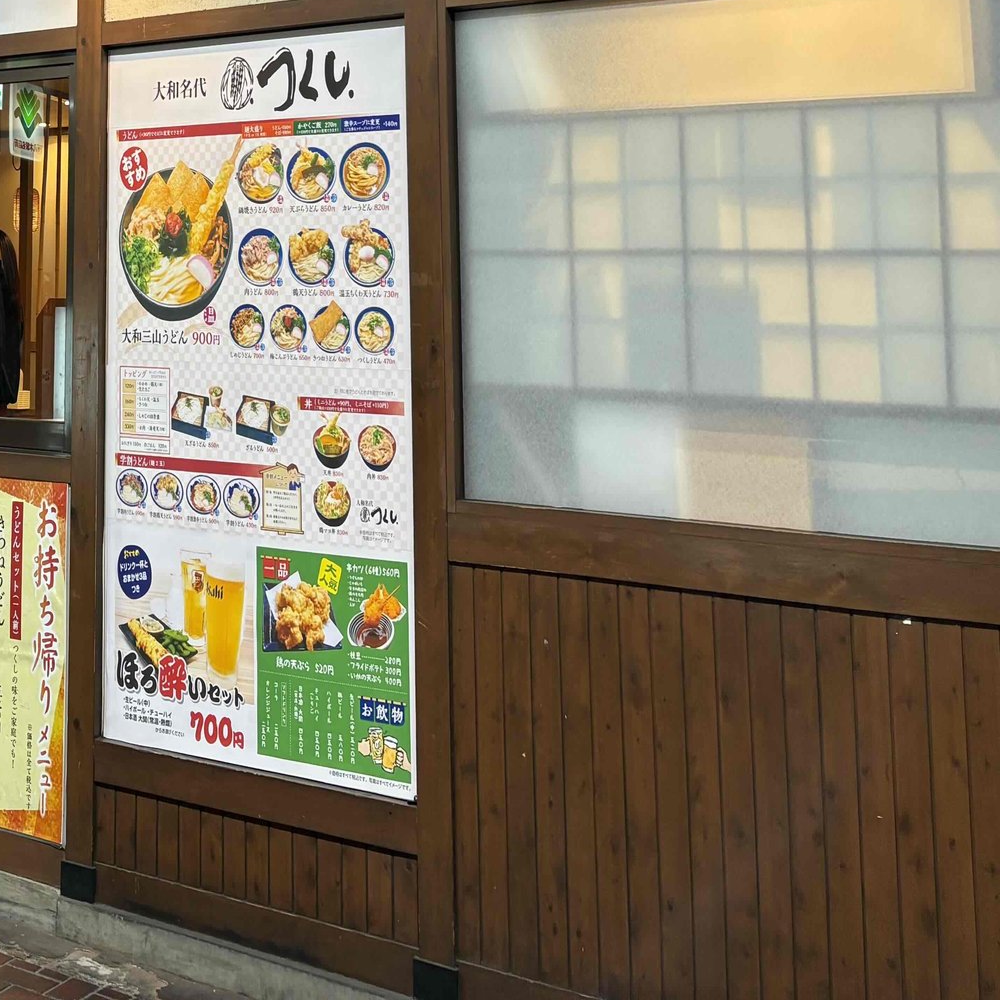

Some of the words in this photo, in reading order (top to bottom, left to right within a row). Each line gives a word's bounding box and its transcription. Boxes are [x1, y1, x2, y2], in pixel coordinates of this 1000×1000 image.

[152, 78, 207, 102] 大和名代
[122, 130, 138, 140] うどん
[121, 326, 188, 345] 大和三山うどん
[192, 331, 220, 346] 900円
[263, 561, 289, 578] 一品
[319, 563, 339, 592] 大人気
[32, 502, 60, 816] お持ち帰りメニュー
[314, 664, 335, 676] 520円
[116, 650, 244, 708] ほろ酔いセット
[361, 703, 404, 725] お飲物
[190, 711, 245, 750] 700円
